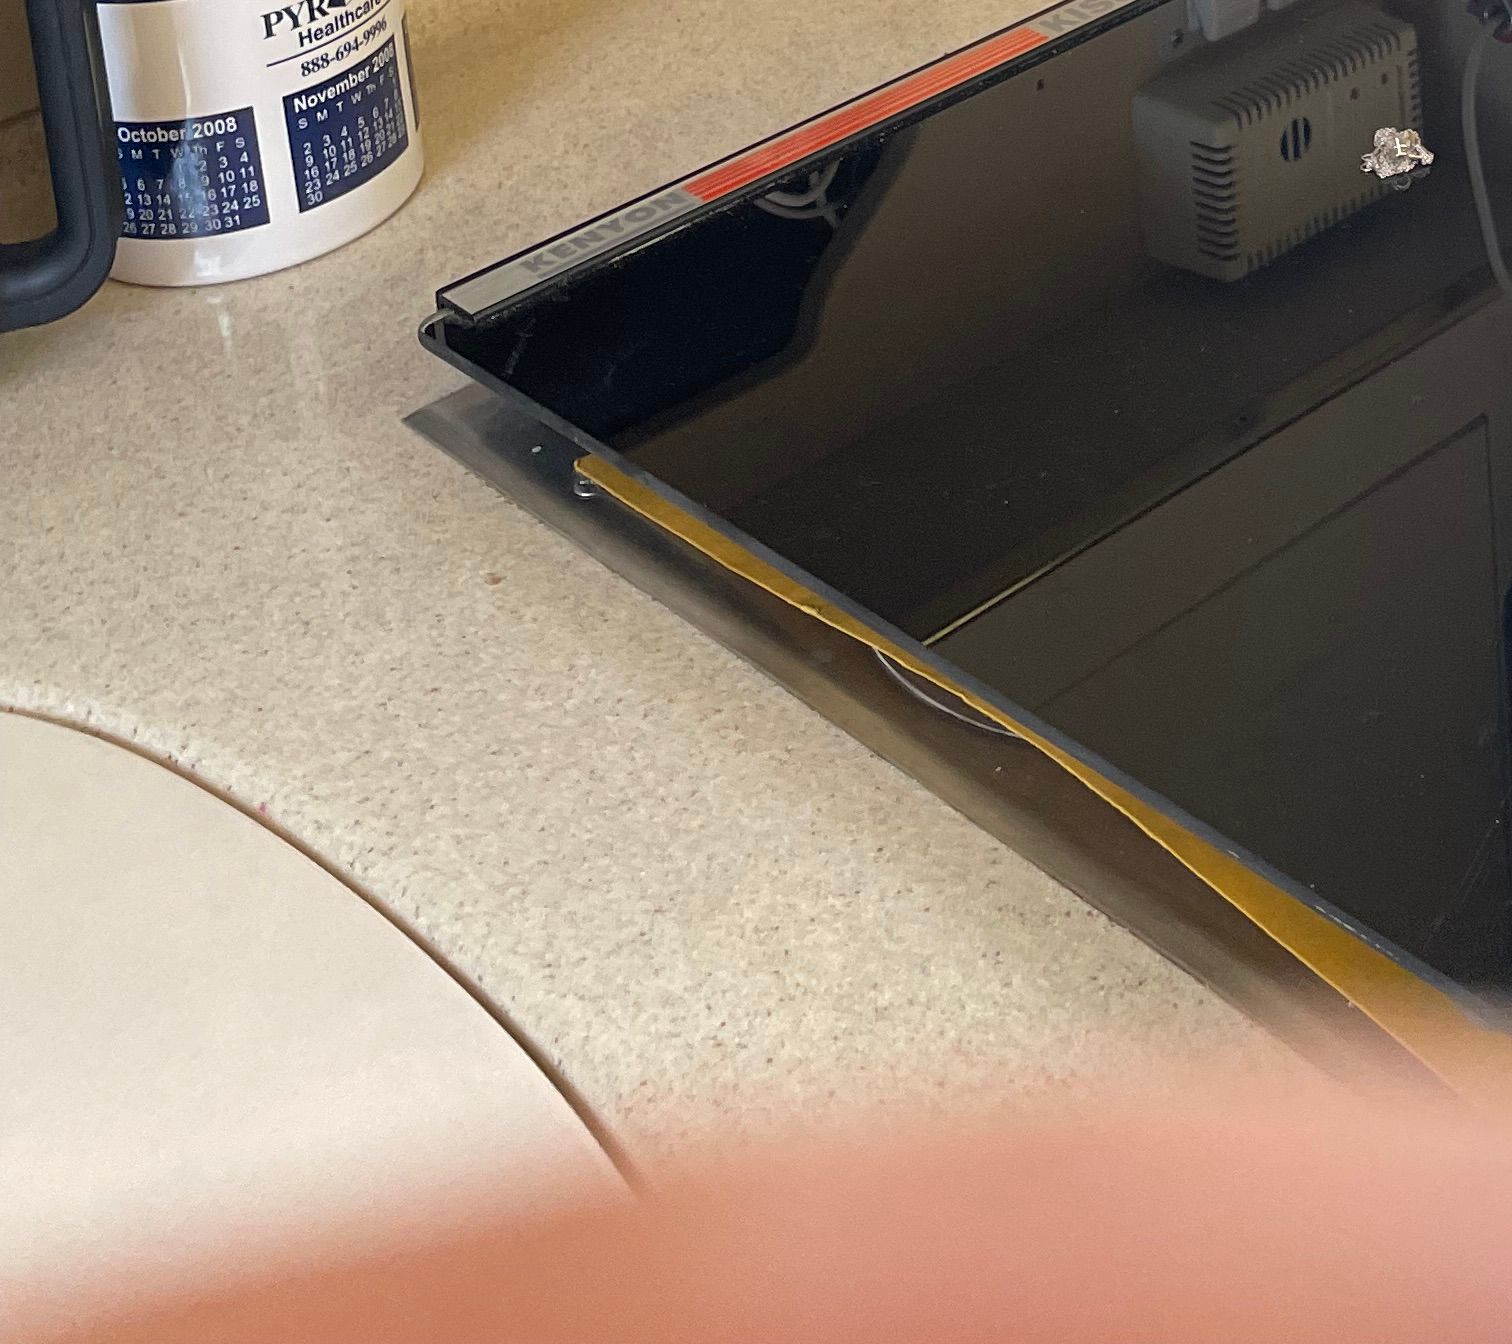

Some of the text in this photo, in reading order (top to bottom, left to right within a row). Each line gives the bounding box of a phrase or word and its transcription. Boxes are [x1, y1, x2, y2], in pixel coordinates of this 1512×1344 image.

[301, 14, 387, 77] 888-694-9996
[294, 65, 369, 113] November
[298, 84, 376, 129] S M T W Th
[118, 117, 237, 142] October 2008
[304, 143, 311, 155] 2
[323, 135, 331, 147] 3
[341, 126, 347, 137] 4
[358, 117, 365, 128] 5
[132, 149, 142, 159] M
[152, 149, 160, 159] T
[216, 141, 224, 152] F
[235, 137, 245, 148] S
[200, 152, 248, 171] 2 3 4
[304, 167, 319, 180] 16
[325, 157, 337, 172] 17
[343, 149, 355, 163] 18
[360, 139, 371, 153] 19
[306, 155, 313, 167] 9
[323, 145, 336, 158] 10
[341, 138, 352, 150] 11
[358, 127, 369, 141] 12
[137, 179, 145, 190] 6
[157, 179, 163, 189] 7
[201, 176, 209, 186] 9
[218, 171, 235, 183] 10
[240, 166, 254, 178] 11
[305, 180, 321, 194] 23
[326, 170, 339, 186] 24
[344, 161, 357, 177] 25
[361, 151, 373, 167] 26
[138, 195, 151, 205] 13
[156, 194, 170, 205] 14
[221, 186, 235, 198] 17
[242, 181, 258, 194] 18
[139, 210, 153, 220] 20
[158, 209, 172, 220] 21
[203, 206, 218, 216] 23
[222, 201, 238, 213] 24
[243, 195, 260, 209] 25
[307, 191, 323, 205] 30
[142, 224, 155, 234] 27
[161, 223, 176, 234] 28
[182, 222, 197, 233] 29
[205, 219, 221, 231] 30
[224, 215, 240, 228] 31
[518, 191, 689, 273] KENYON
